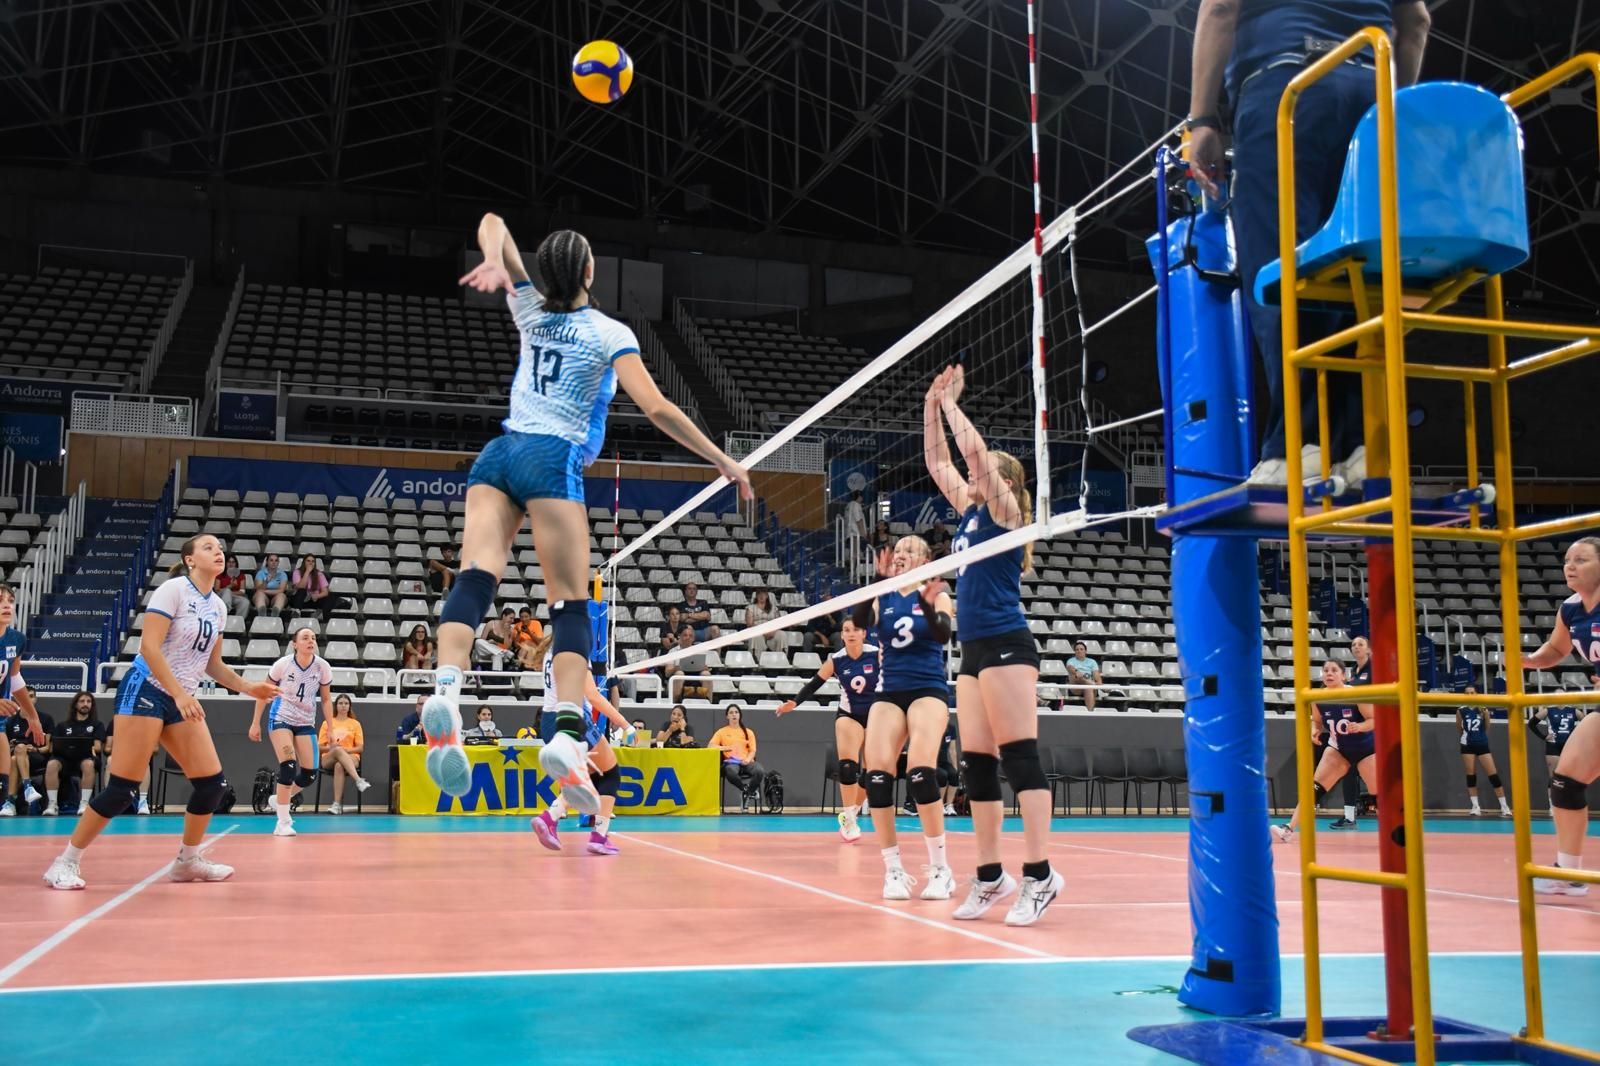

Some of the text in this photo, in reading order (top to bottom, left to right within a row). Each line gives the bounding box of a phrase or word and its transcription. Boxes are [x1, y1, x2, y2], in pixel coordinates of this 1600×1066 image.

[531, 344, 563, 397] 12
[1, 383, 62, 398] Andorra
[402, 477, 467, 496] andor
[192, 618, 213, 652] 19
[891, 616, 914, 648] 3
[56, 682, 81, 690] teleco
[296, 683, 305, 702] 4
[850, 675, 866, 694] 9
[1326, 718, 1350, 735] 10
[1465, 718, 1481, 731] 12
[1558, 718, 1570, 730] 5
